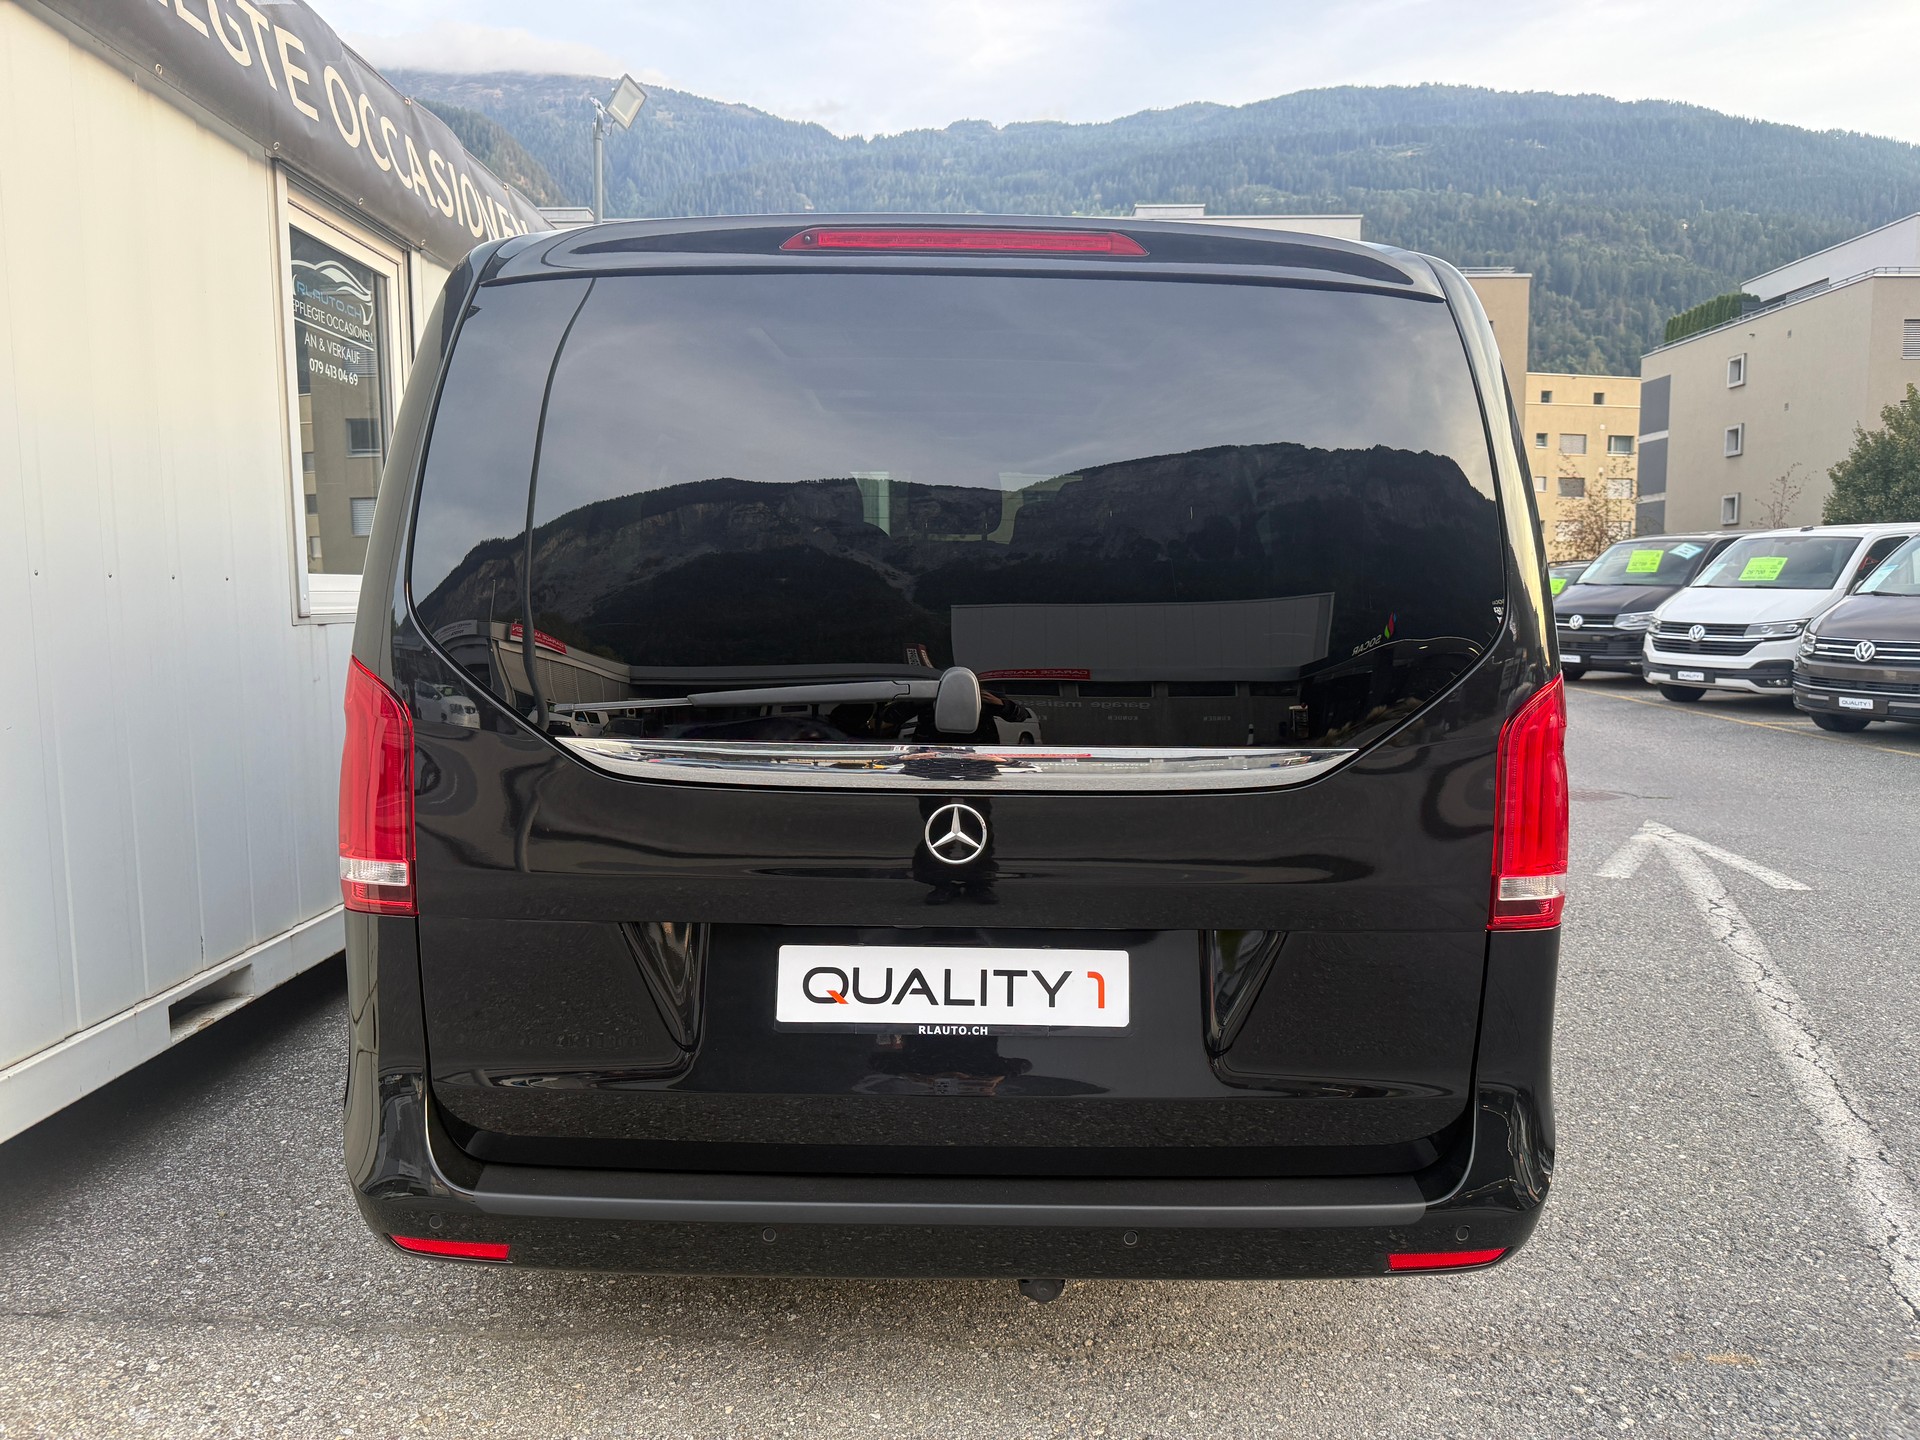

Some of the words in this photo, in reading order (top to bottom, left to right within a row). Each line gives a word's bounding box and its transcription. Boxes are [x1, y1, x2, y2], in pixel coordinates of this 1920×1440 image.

[296, 281, 362, 320] RLAUTO.CH
[326, 313, 373, 343] OCCASIONEN
[304, 332, 317, 349] AN
[319, 337, 326, 353] &
[327, 341, 361, 365] VERKAUF
[309, 357, 324, 375] 079
[325, 366, 337, 380] 413
[338, 370, 348, 383] 04
[348, 373, 359, 386] 69
[802, 966, 1073, 1008] QUALITY
[1087, 971, 1105, 1009] 1
[918, 1024, 989, 1036] RLAUTO.CH
